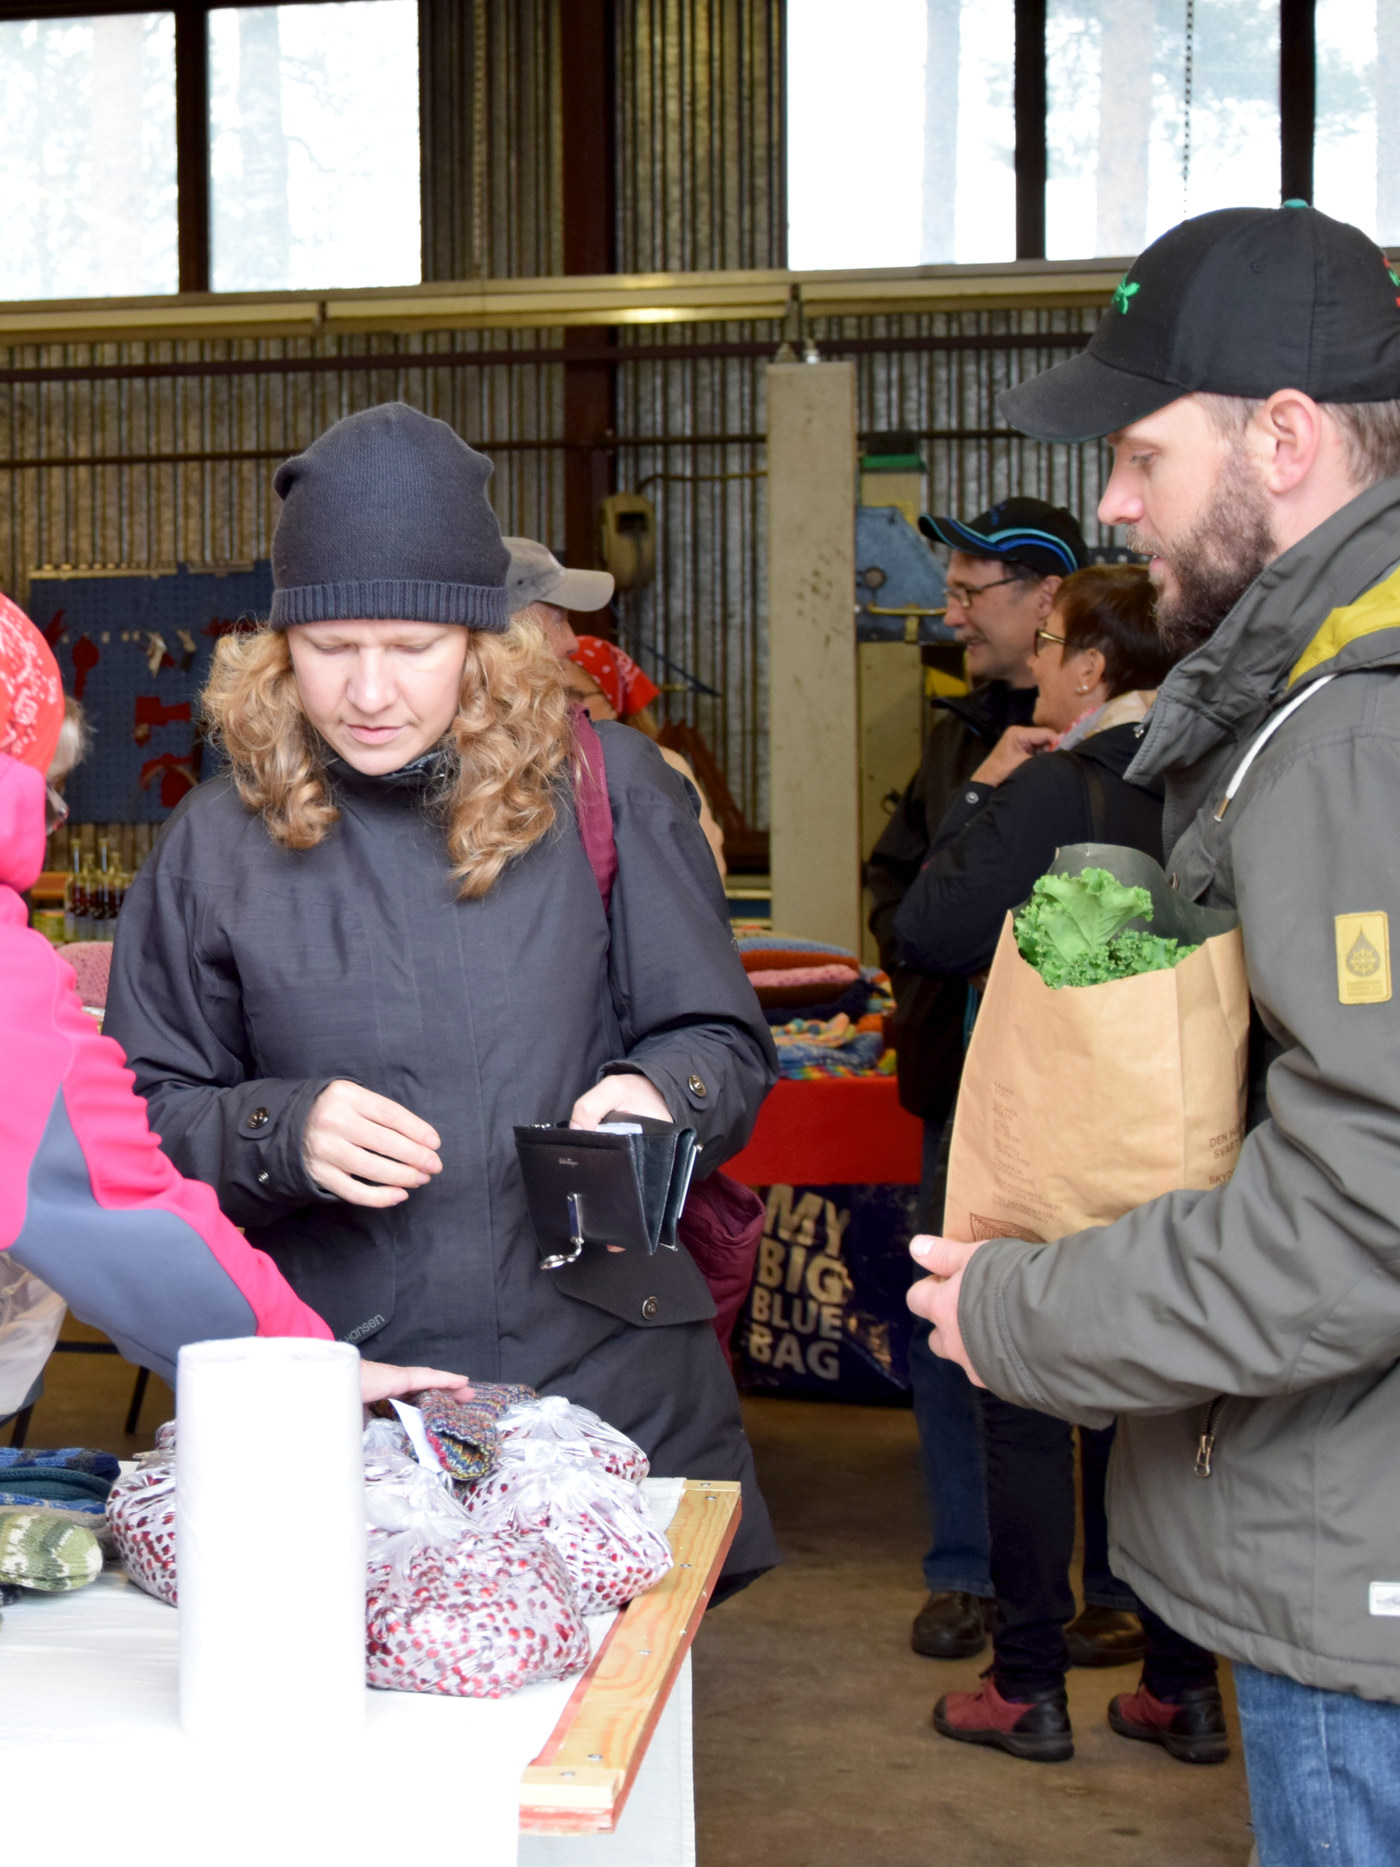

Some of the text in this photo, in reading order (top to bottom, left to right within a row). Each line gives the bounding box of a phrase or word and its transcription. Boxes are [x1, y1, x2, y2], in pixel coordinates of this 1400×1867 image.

[1209, 1132, 1228, 1148] DEN
[764, 1184, 850, 1256] MY
[756, 1235, 850, 1305] BIG
[752, 1285, 844, 1341] BLUE
[749, 1322, 840, 1381] BAG
